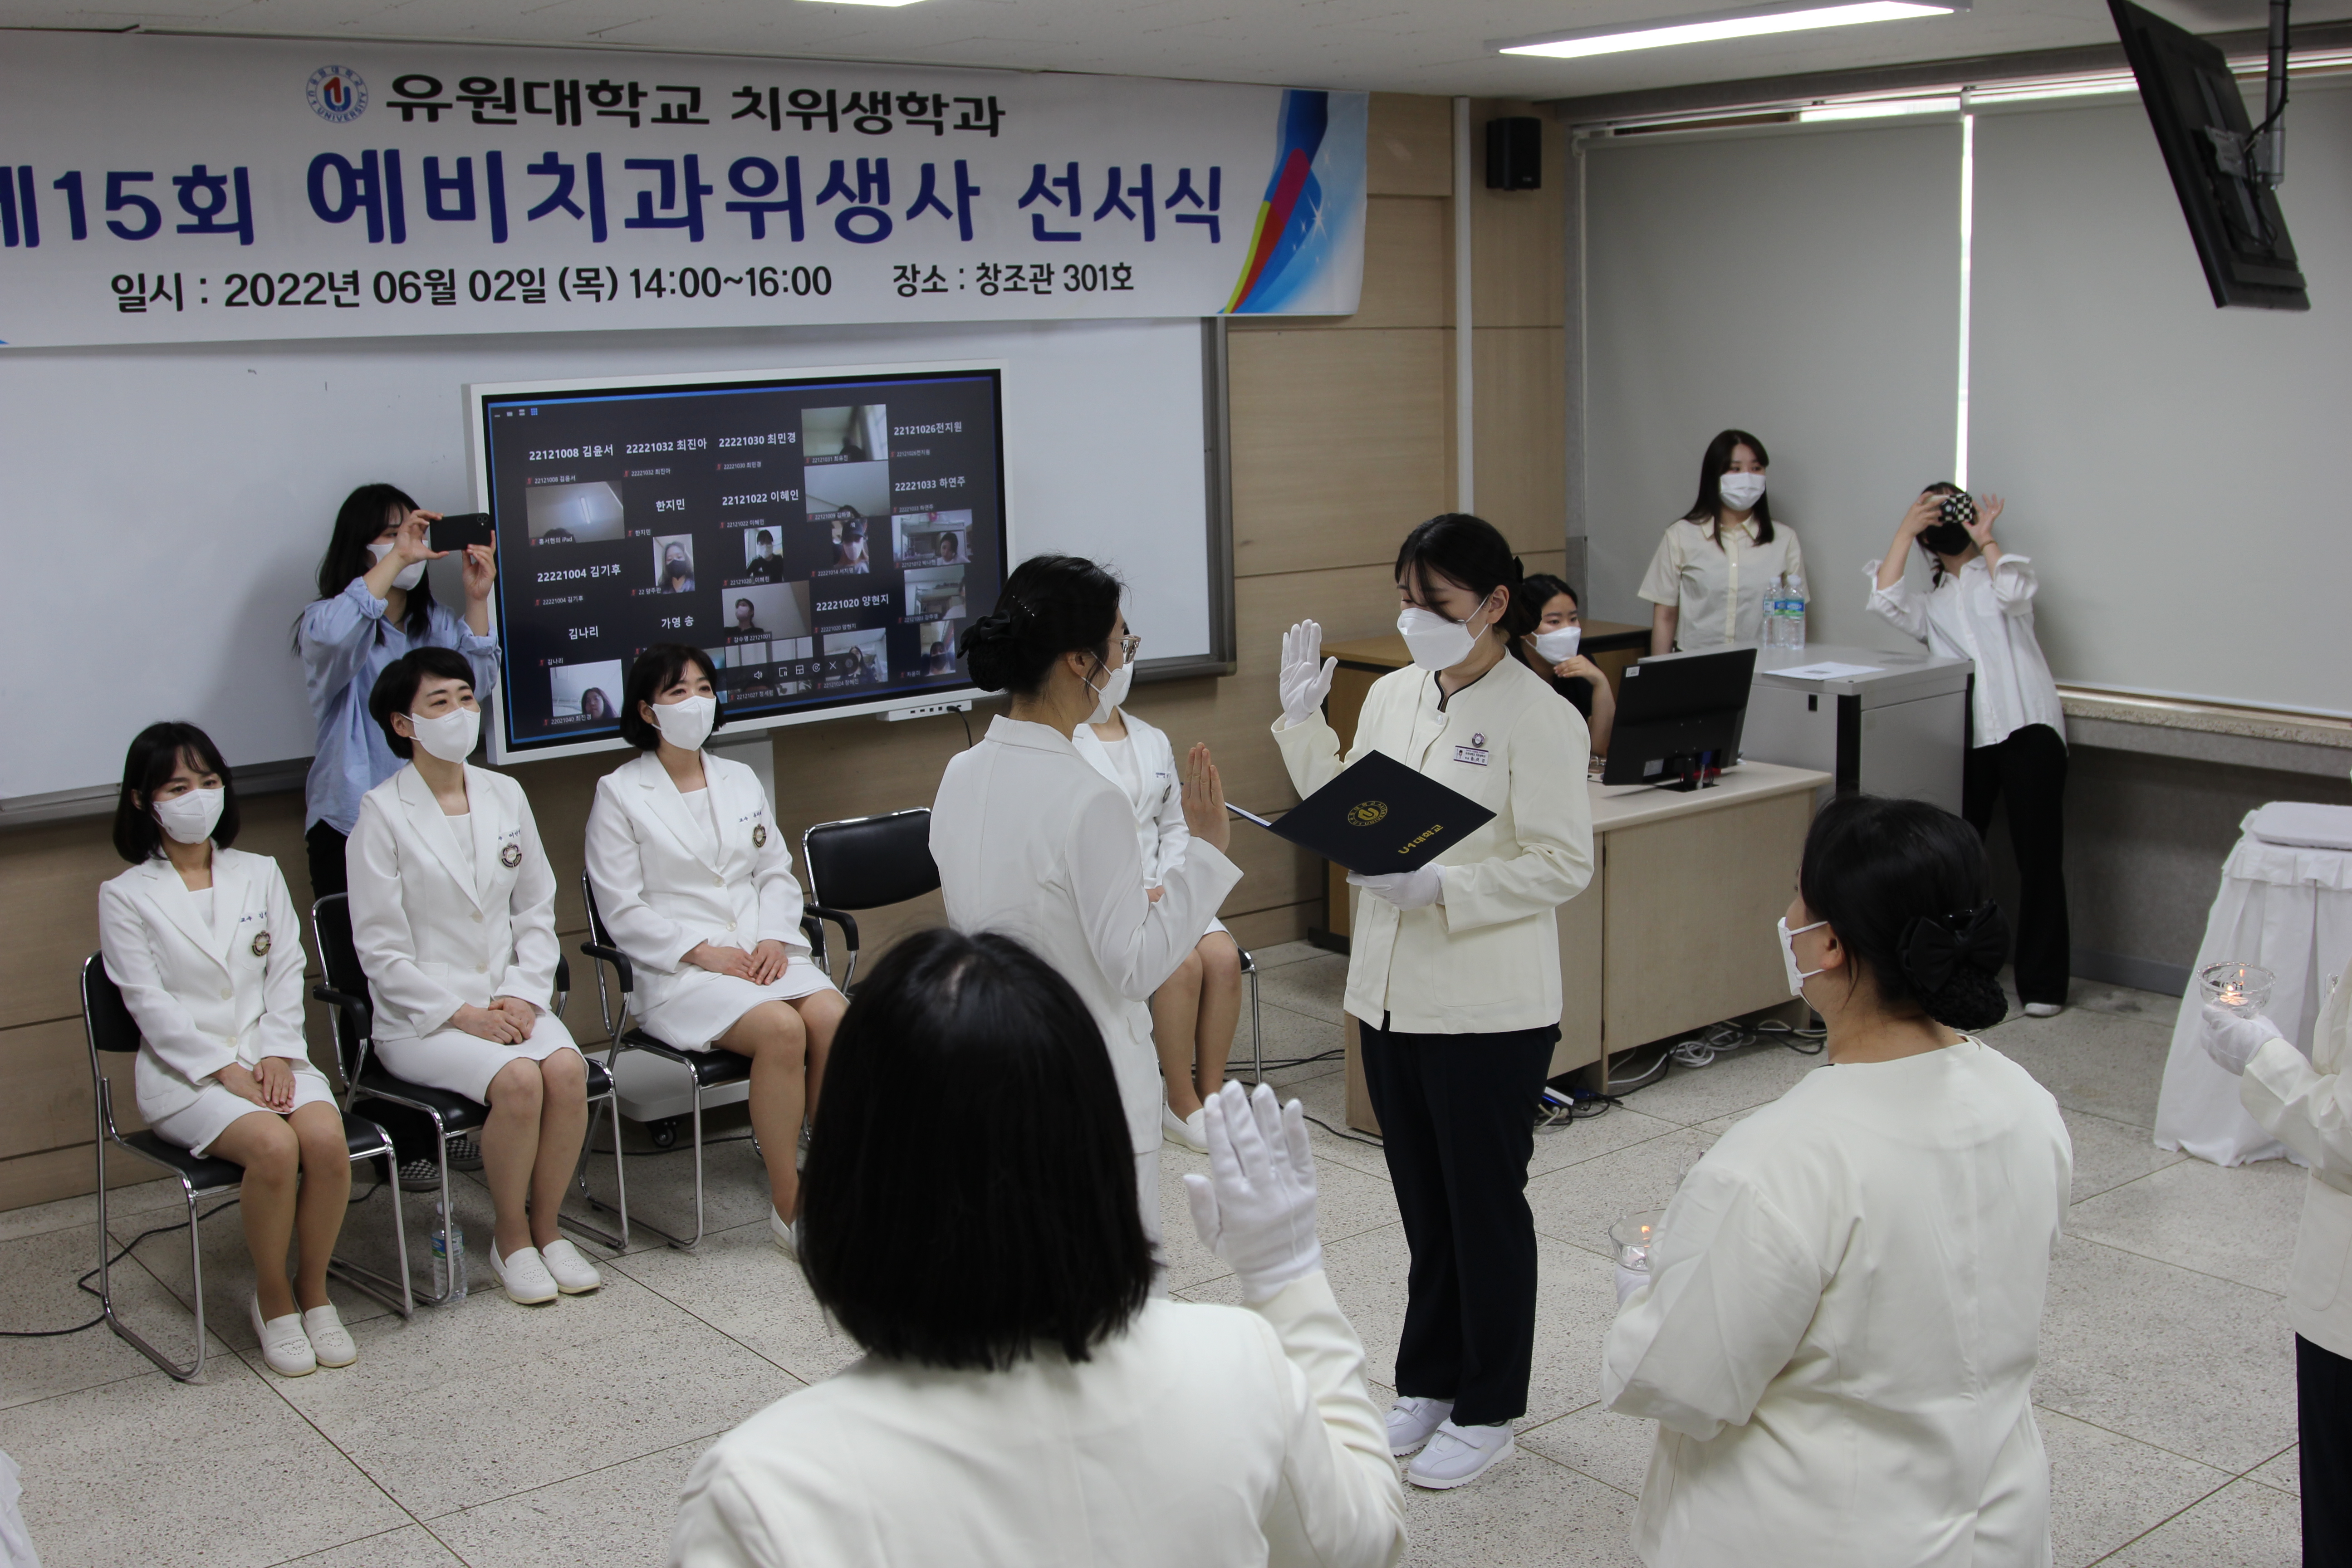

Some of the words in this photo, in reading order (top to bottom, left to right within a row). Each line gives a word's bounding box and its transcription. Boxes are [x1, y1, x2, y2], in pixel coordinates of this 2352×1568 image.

[387, 74, 710, 129] 유원대학교
[731, 85, 1006, 137] 치위생학과
[307, 149, 980, 244] 예비치과위생사
[1018, 162, 1221, 243] 선서식
[893, 264, 949, 297] 장소
[959, 268, 965, 289] :
[975, 262, 1055, 296] 창조관
[1063, 262, 1134, 292] 301호
[111, 273, 183, 313] 일시
[200, 278, 208, 304] :
[224, 270, 360, 308] 2022년
[373, 268, 456, 305] 06월
[468, 268, 546, 304] 02일
[559, 266, 618, 303] (목)
[629, 266, 832, 298] 14:00~16:00
[894, 421, 962, 436] 22121026전지원
[626, 441, 674, 454] 22221032
[676, 437, 707, 451] 최진아
[719, 435, 764, 447] 22221030
[767, 431, 796, 445] 최민경
[529, 448, 579, 461] 22121008
[583, 444, 613, 458] 김윤서
[895, 480, 936, 491] 22221033
[939, 476, 966, 489] 하연주
[655, 498, 686, 512] 한지민
[722, 493, 768, 506] 22121022
[770, 489, 799, 502] 이혜인
[537, 568, 587, 583] 22221004
[590, 564, 621, 578] 김기후
[543, 597, 566, 605] 22221004
[816, 599, 859, 612] 22221020
[862, 593, 889, 607] 양현지
[661, 617, 681, 629] 가영
[684, 616, 694, 627] 송
[568, 626, 599, 640] 김나리
[547, 657, 563, 666] 김나리
[1398, 824, 1444, 854] U1대학교
